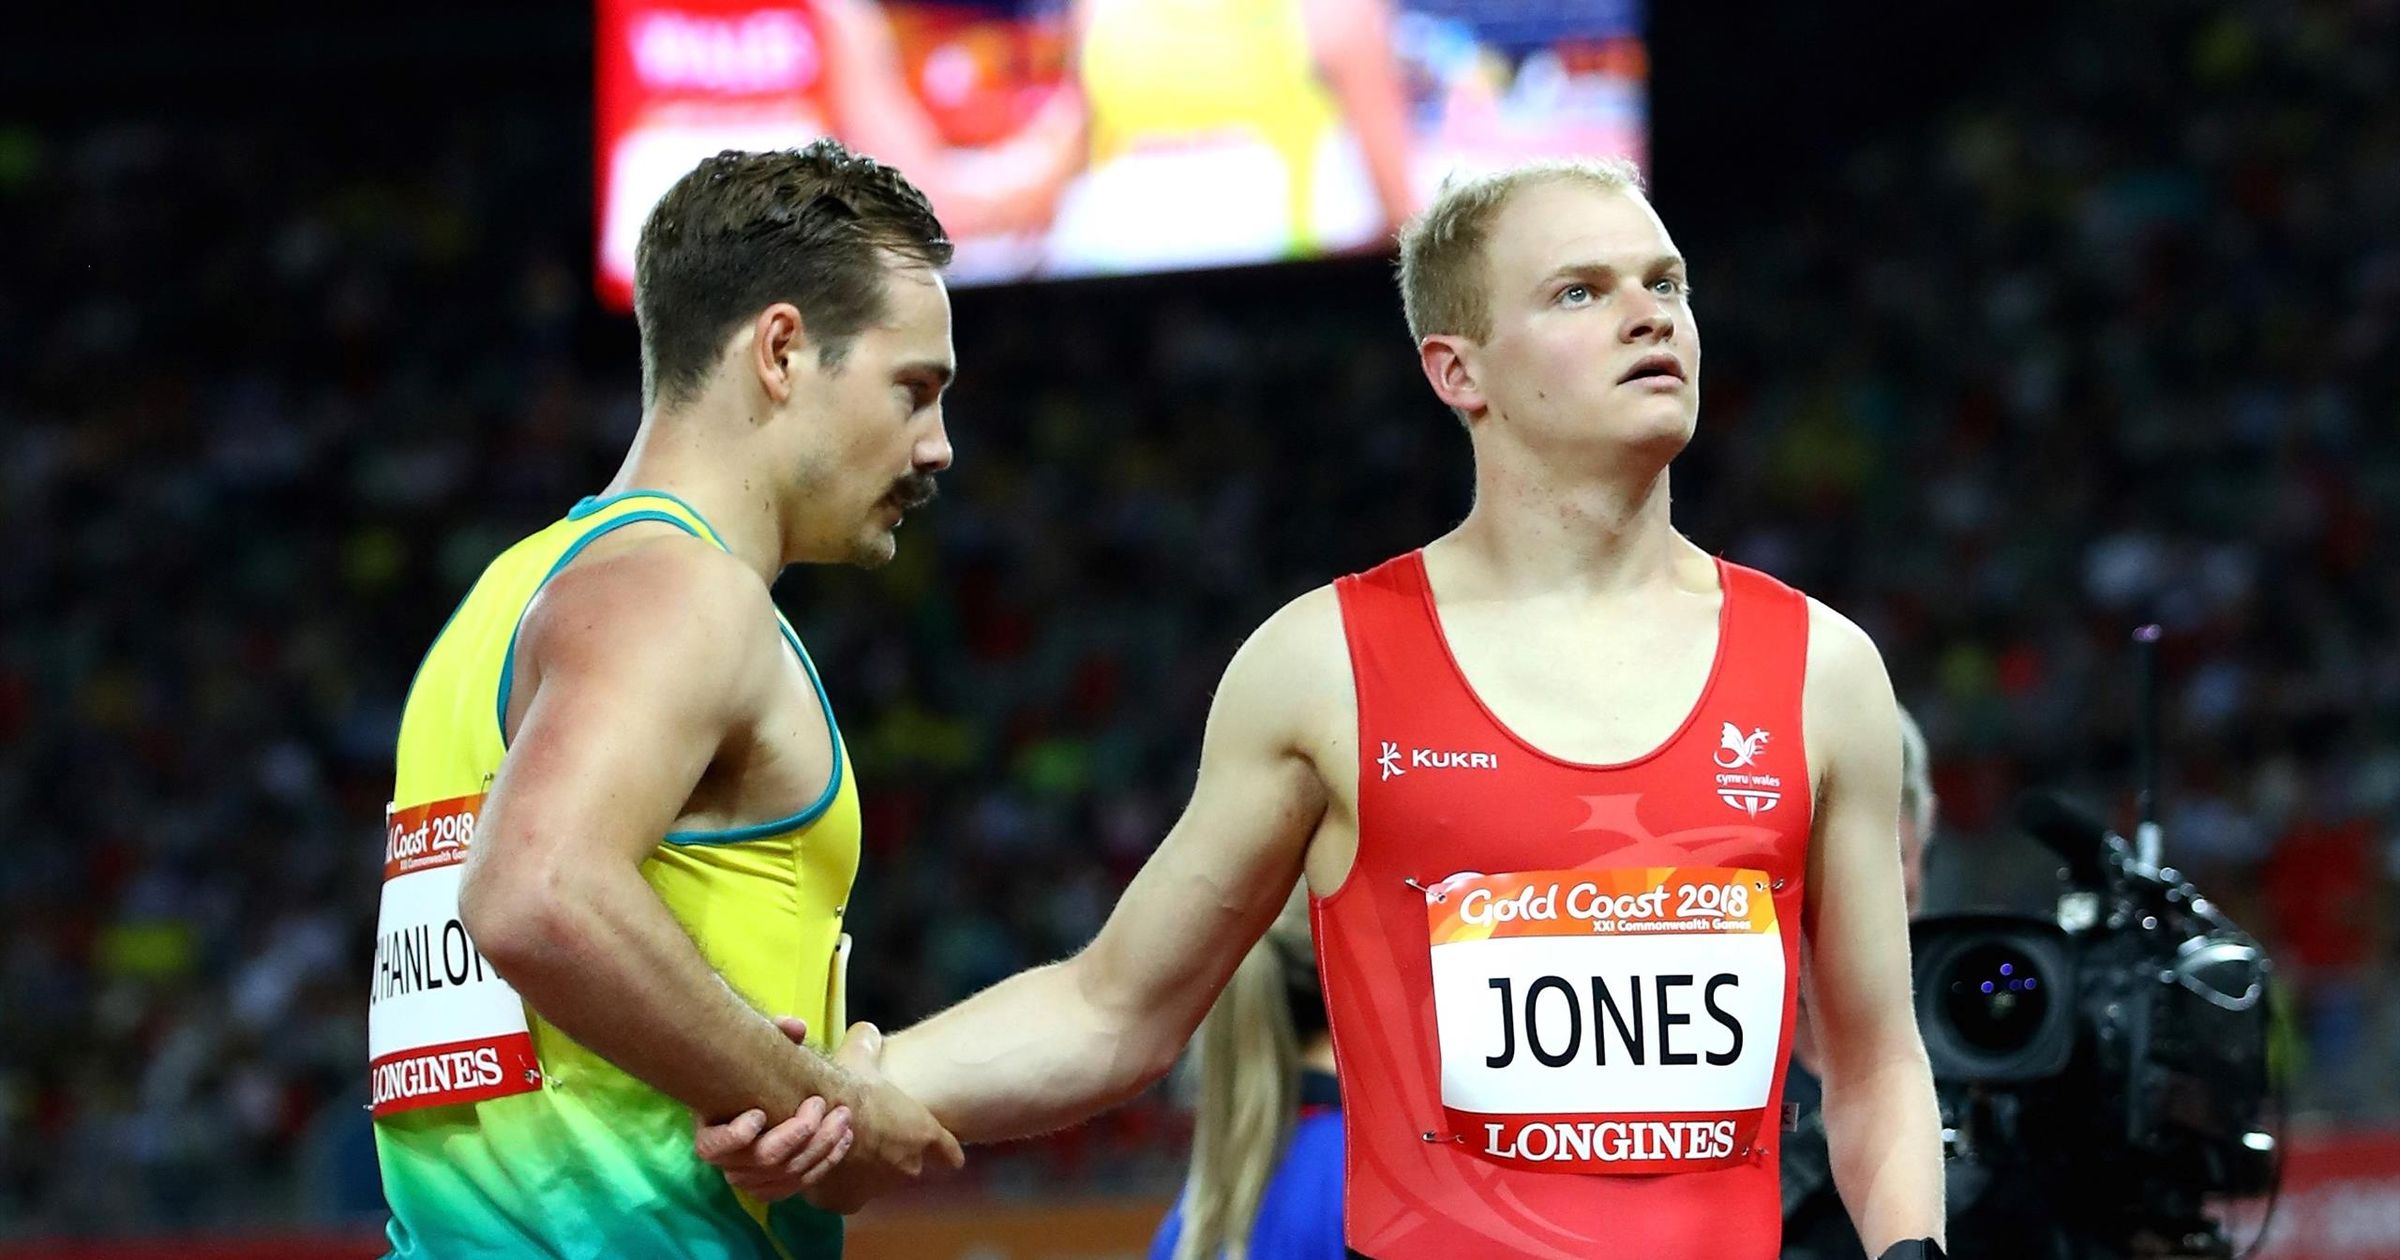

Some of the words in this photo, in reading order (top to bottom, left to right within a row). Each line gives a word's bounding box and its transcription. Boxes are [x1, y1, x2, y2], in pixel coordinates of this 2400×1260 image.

[1411, 748, 1498, 769] KUKRI
[1715, 773, 1749, 785] cymru
[1752, 774, 1780, 787] wales
[393, 822, 430, 860] Coast
[432, 811, 475, 851] 2018
[1459, 884, 1559, 927] Gold
[1566, 882, 1671, 920] Coast
[1676, 883, 1750, 919] 2018
[1592, 919, 1615, 932] XXI
[1617, 918, 1710, 932] Commonwealth
[1711, 917, 1751, 931] Games
[1485, 972, 1744, 1069] JONES
[372, 1046, 503, 1105] LONGINES
[1483, 1119, 1738, 1162] LONGINES
